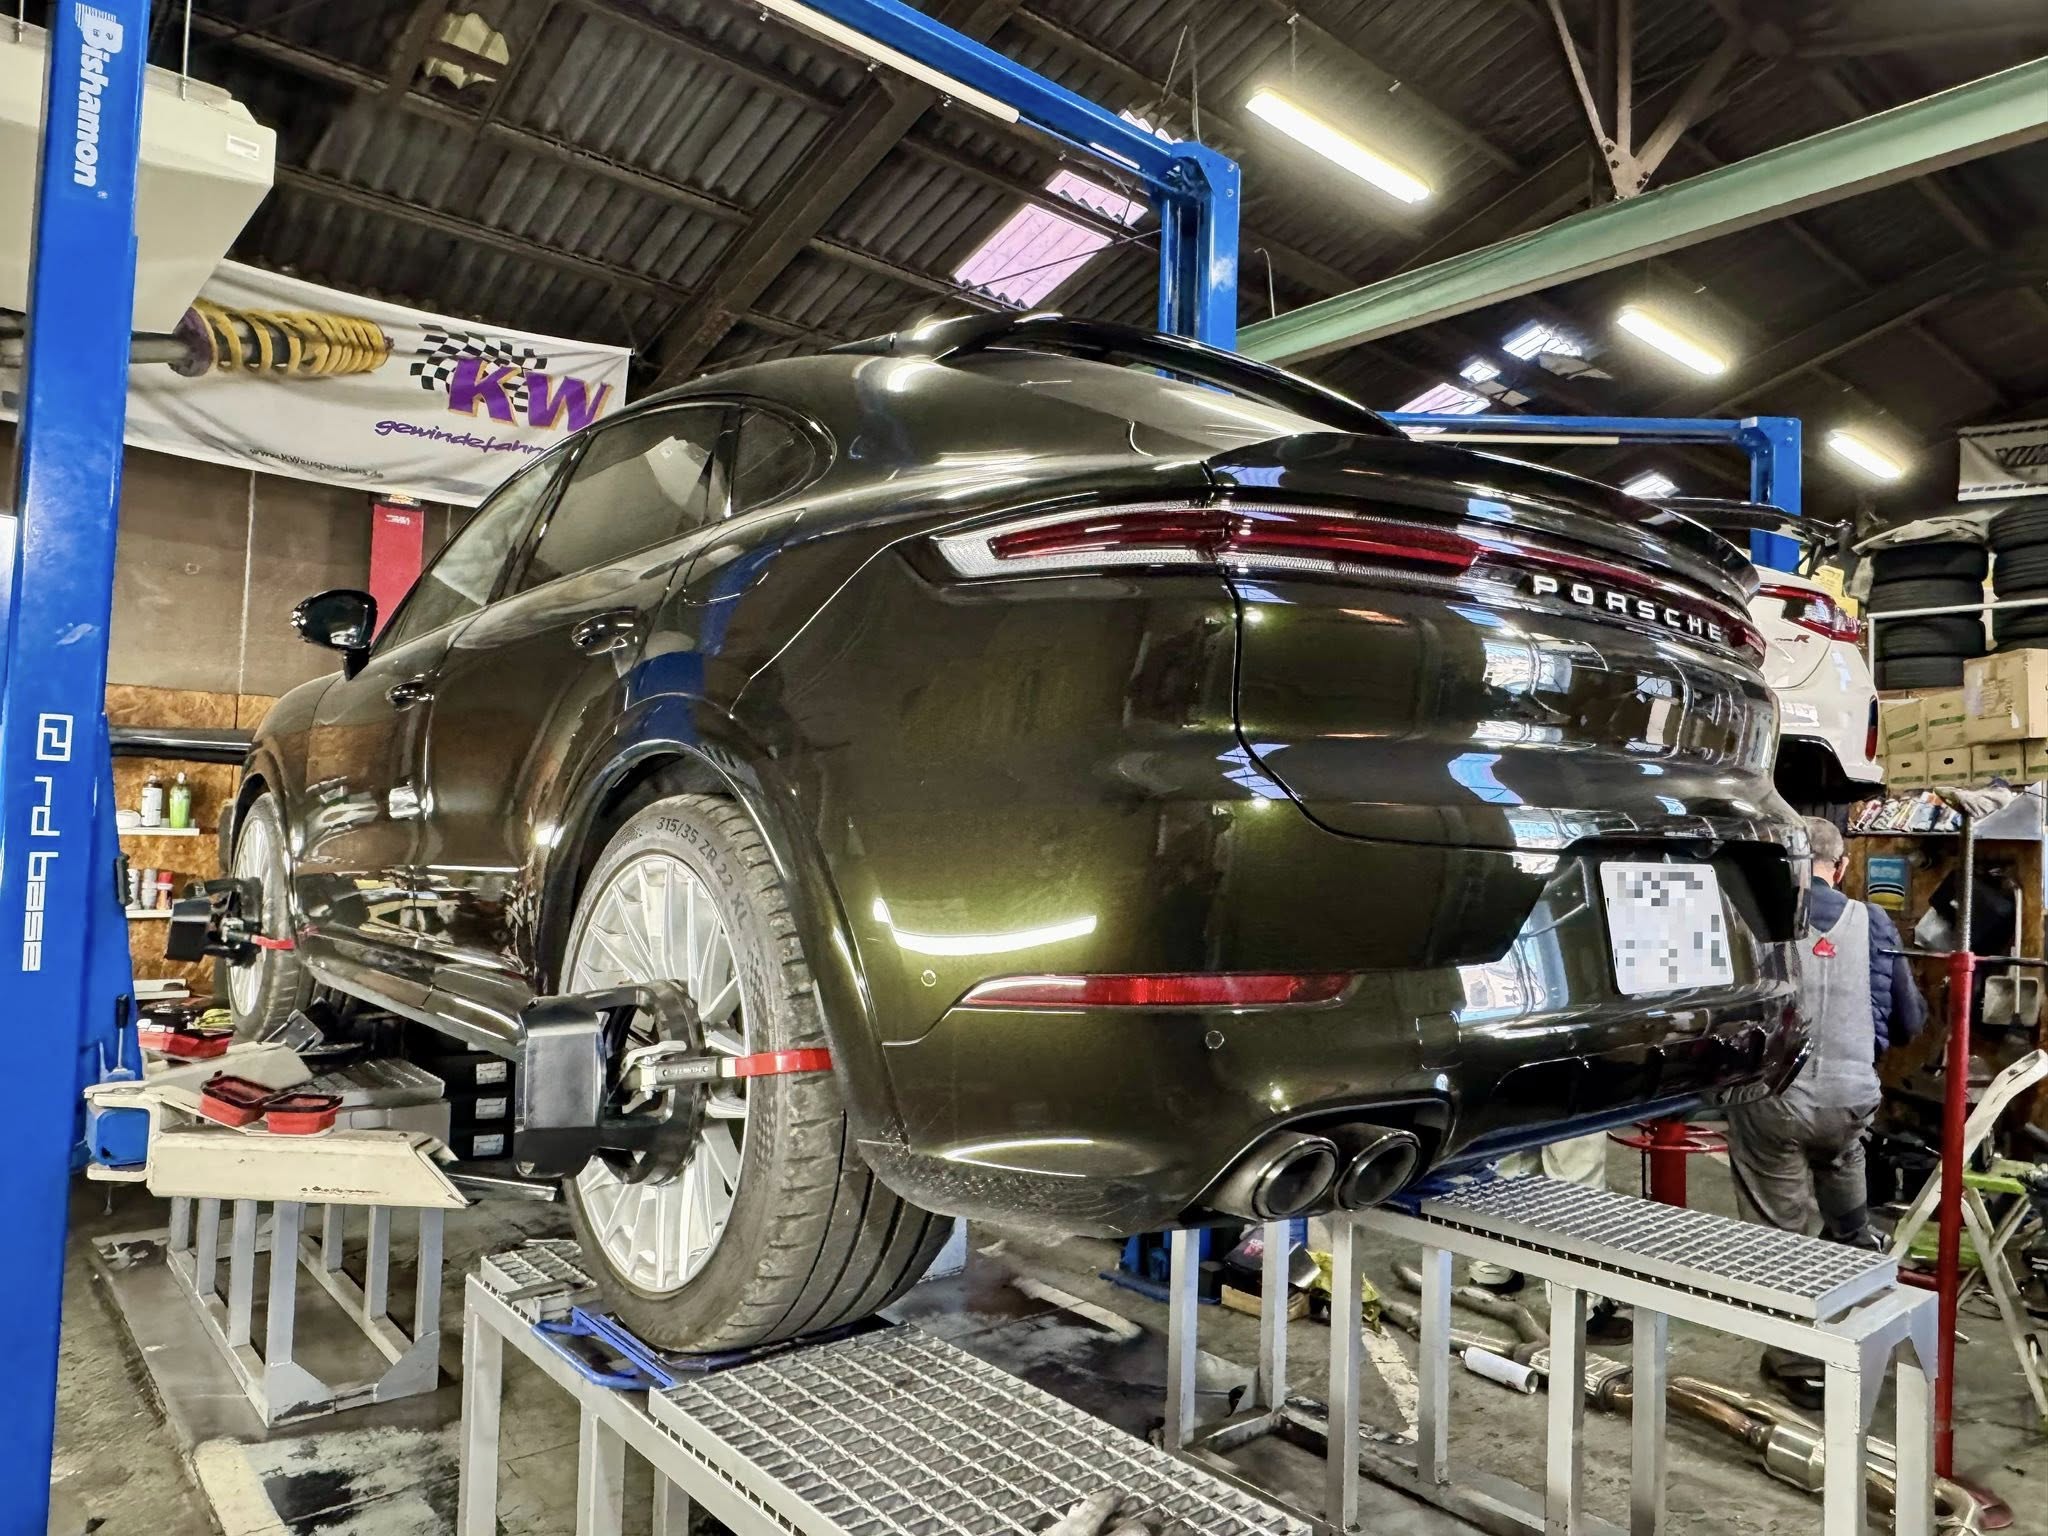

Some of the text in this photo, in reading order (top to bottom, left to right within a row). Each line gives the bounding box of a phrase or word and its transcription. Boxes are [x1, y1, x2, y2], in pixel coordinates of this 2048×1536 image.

[73, 3, 124, 187] Bishamon
[448, 358, 614, 431] KW
[1533, 575, 1721, 642] PORSCHE
[656, 817, 699, 845] 315/35
[698, 840, 718, 866] ZR
[22, 852, 58, 971] base
